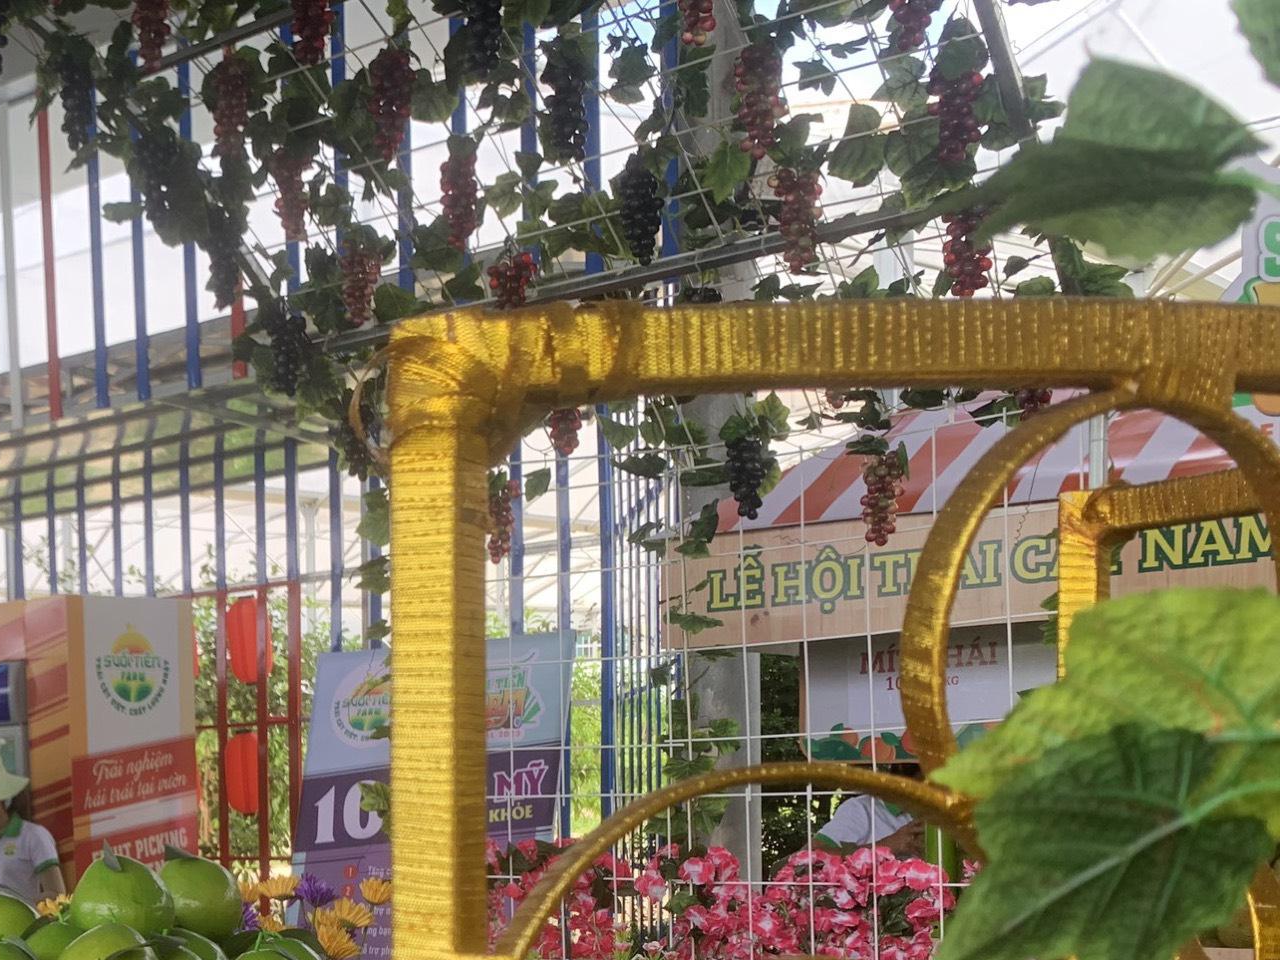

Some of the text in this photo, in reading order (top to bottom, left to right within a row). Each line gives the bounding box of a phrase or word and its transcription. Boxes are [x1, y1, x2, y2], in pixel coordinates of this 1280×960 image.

[707, 543, 764, 612] LỄ
[770, 544, 865, 614] HỘI
[860, 643, 902, 675] MÍ
[493, 759, 549, 803] MỸ
[135, 827, 188, 859] PICKING
